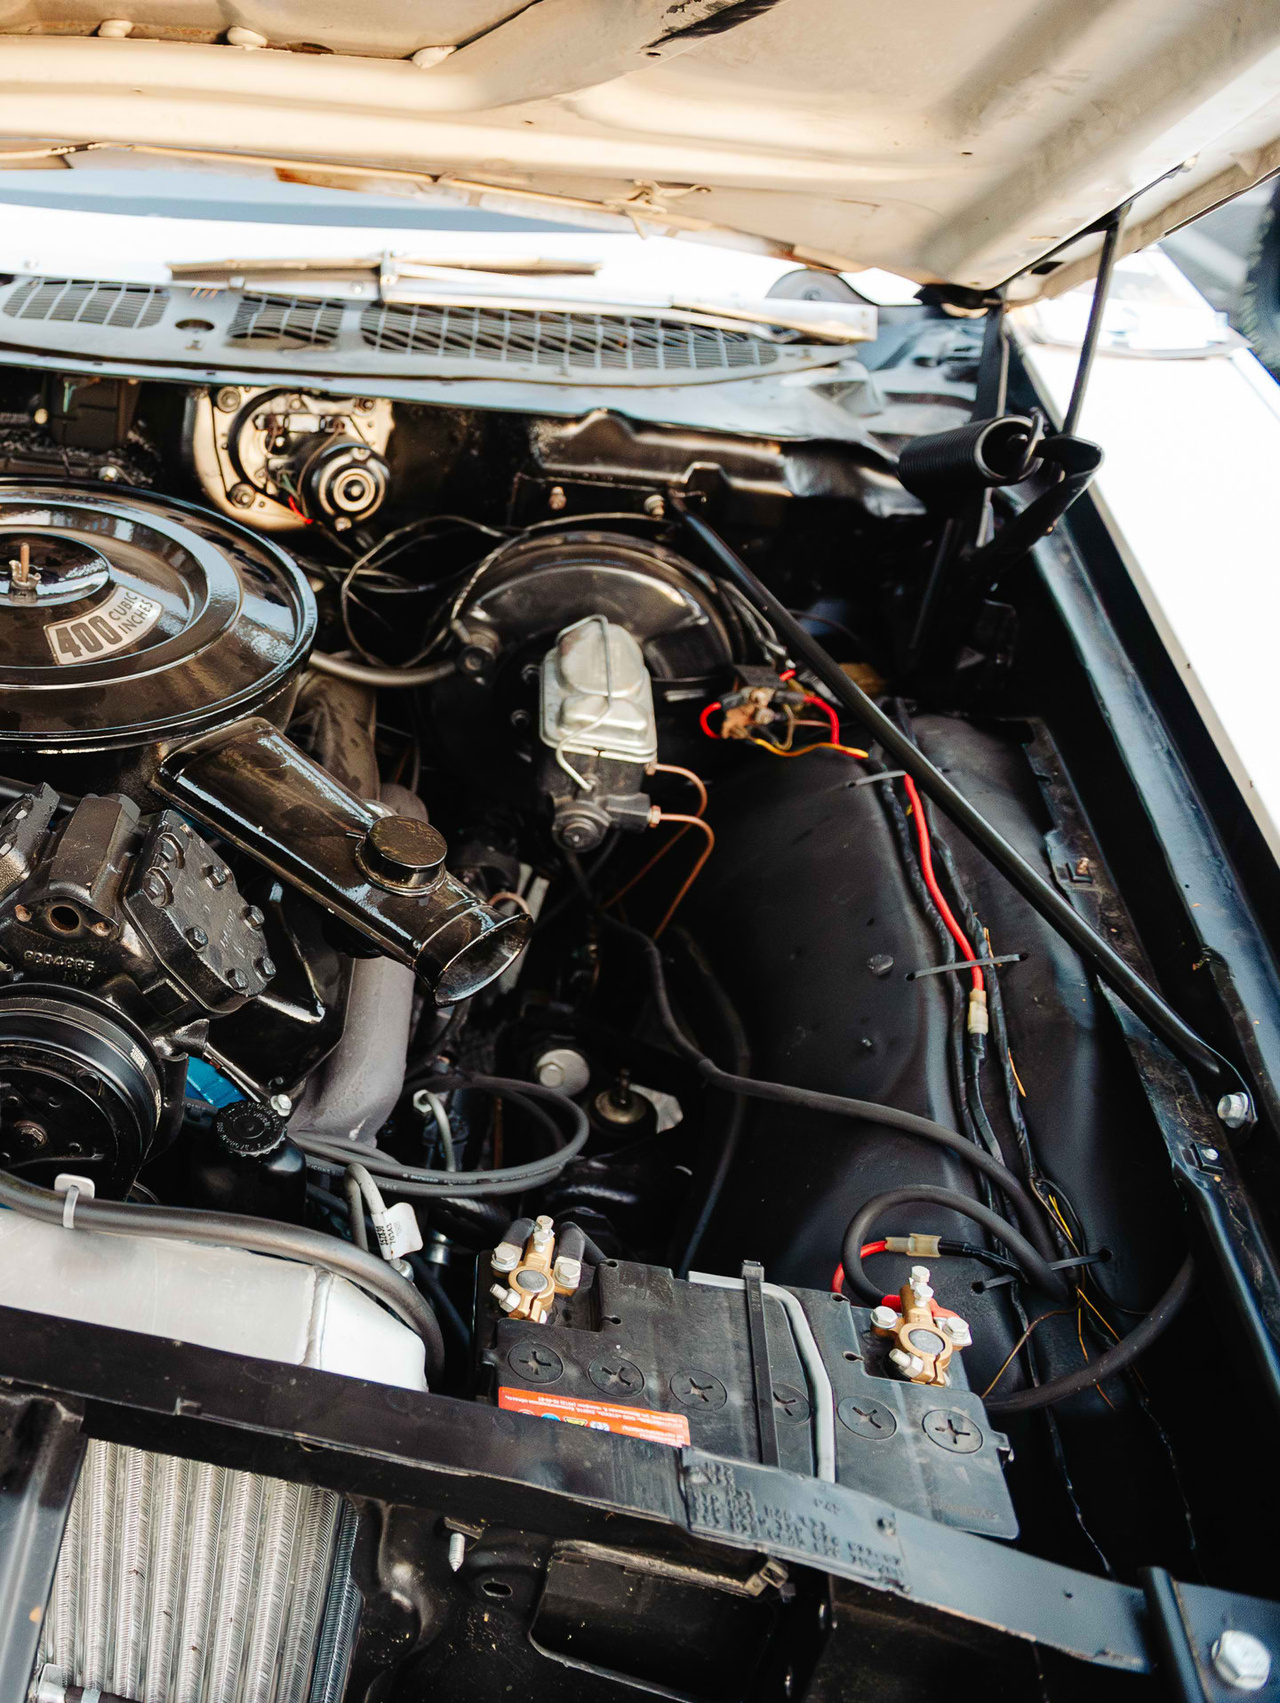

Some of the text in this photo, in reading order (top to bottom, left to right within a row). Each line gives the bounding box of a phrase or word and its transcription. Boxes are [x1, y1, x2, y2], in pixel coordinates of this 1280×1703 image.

[109, 592, 138, 621] CUBIC
[117, 598, 153, 635] INCHES
[55, 615, 123, 658] 400
